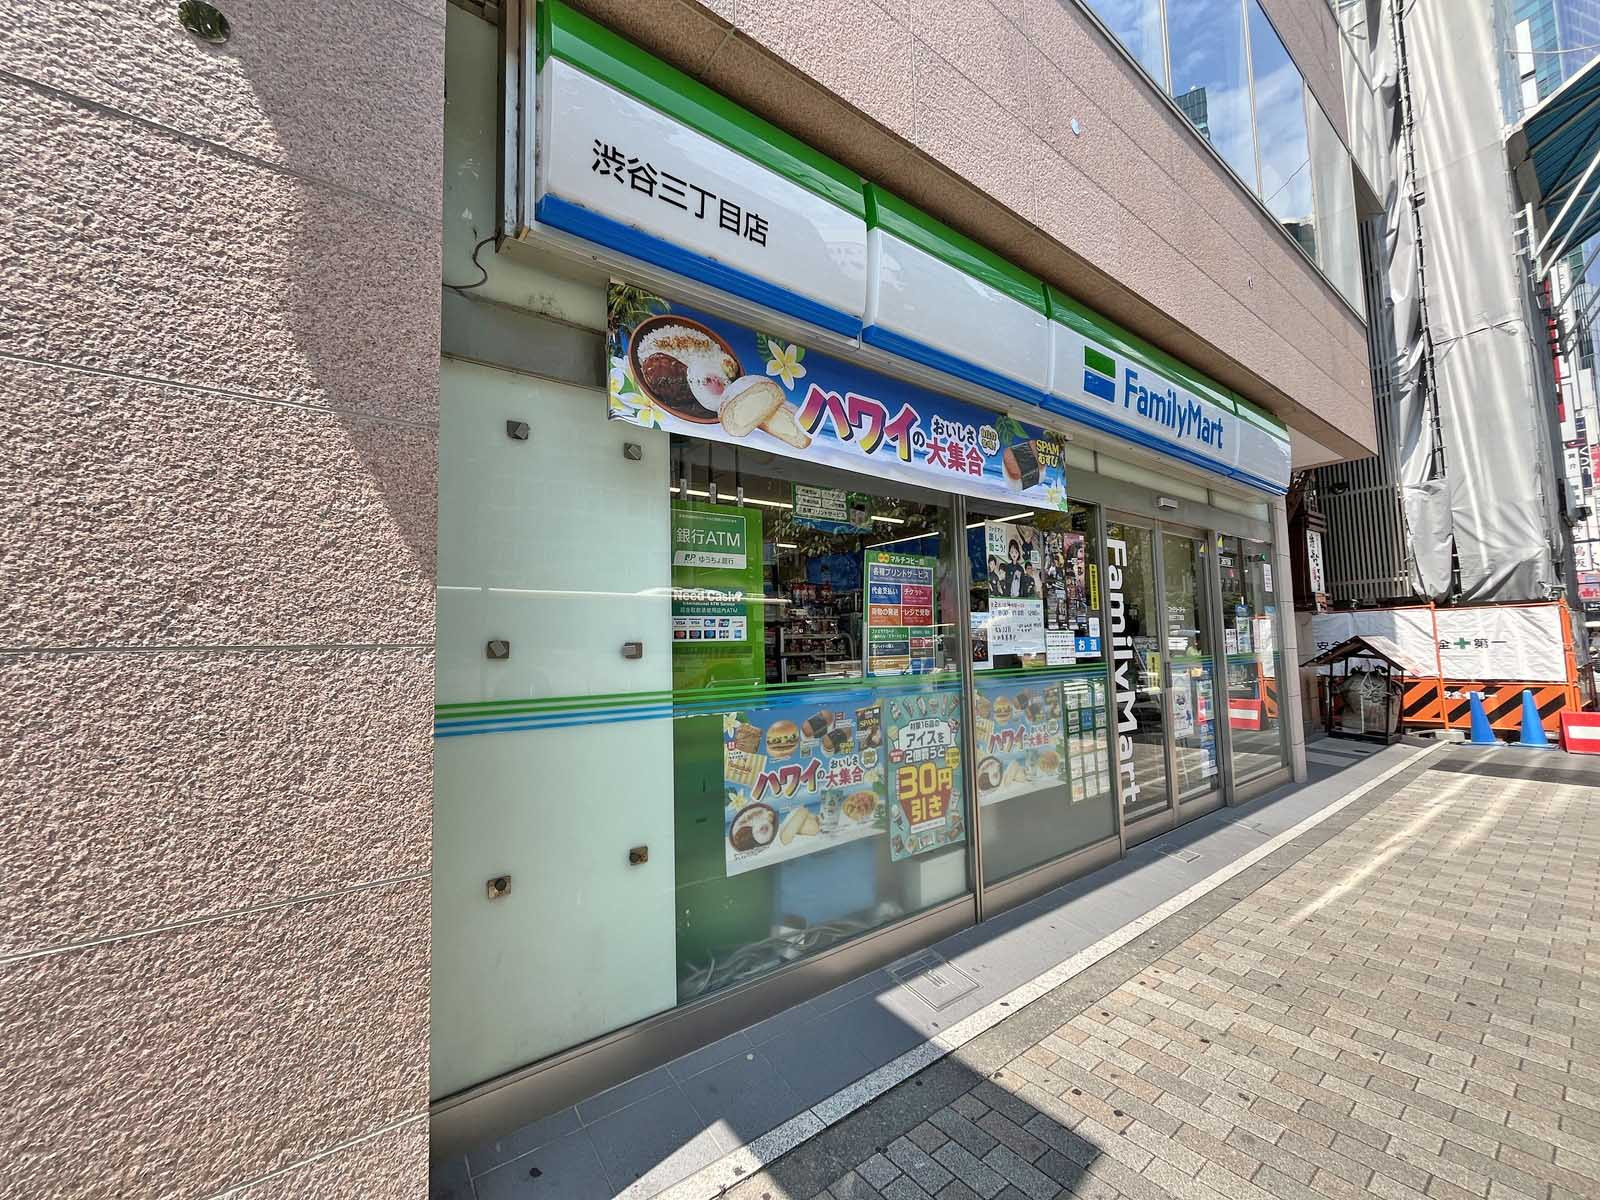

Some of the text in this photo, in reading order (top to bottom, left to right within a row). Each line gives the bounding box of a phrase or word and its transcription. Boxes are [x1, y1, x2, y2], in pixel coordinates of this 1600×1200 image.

[592, 139, 768, 247] 渋谷三丁目店
[1124, 367, 1223, 449] FamilyMart
[798, 386, 926, 462] ハワイの
[932, 417, 976, 446] おいしさ
[925, 438, 984, 477] 大集合
[1036, 439, 1059, 456] SPAM
[1037, 452, 1058, 468] むすび
[676, 527, 740, 548] 銀行ATM
[673, 590, 743, 602] Need Cash?
[1106, 538, 1141, 805] FamilyMart
[906, 730, 945, 748] アイスを
[830, 756, 859, 768] おいしさ
[752, 759, 825, 800] ハワイの
[826, 766, 864, 787] 大集合
[900, 762, 952, 800] 30円
[911, 795, 942, 822] 引き
